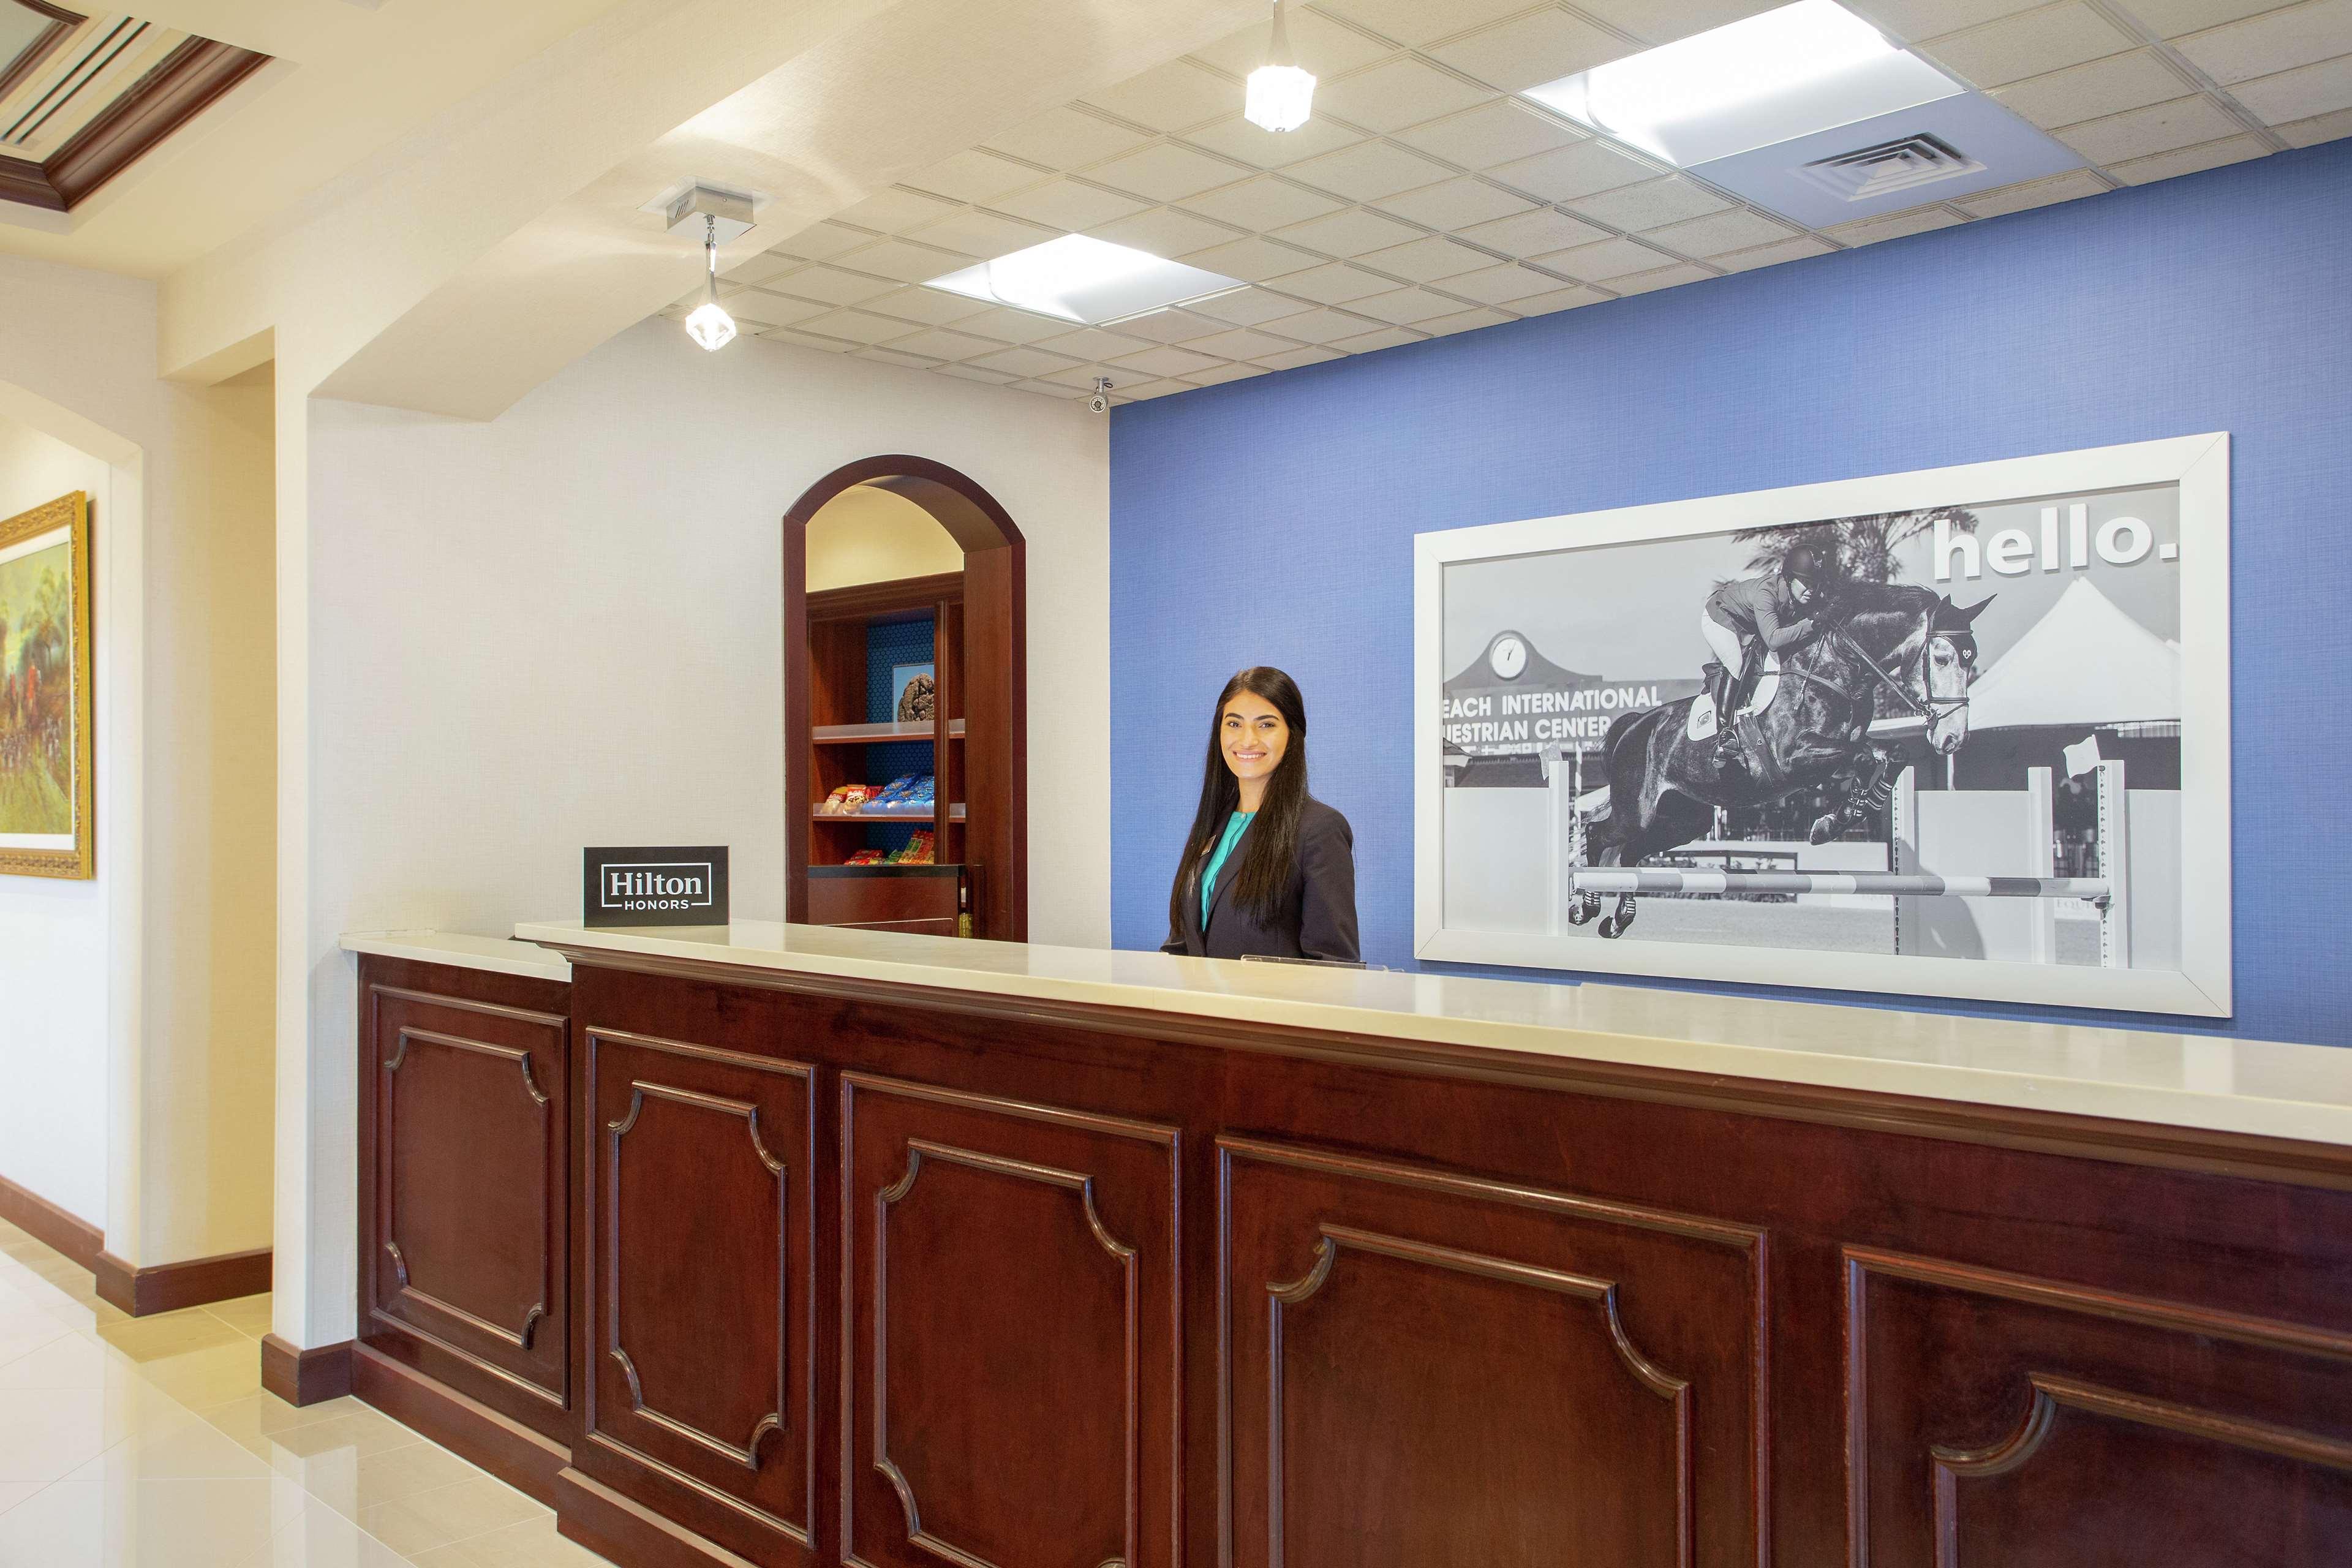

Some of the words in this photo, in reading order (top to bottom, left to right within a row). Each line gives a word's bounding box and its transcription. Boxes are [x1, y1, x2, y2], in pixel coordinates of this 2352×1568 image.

[1934, 503, 2179, 581] hello.
[1443, 696, 1491, 718] EACH
[1502, 686, 1662, 715] INTERNATIONAL
[1534, 715, 1611, 740] CENTER
[610, 872, 703, 896] Hilton
[624, 899, 690, 911] HONORS
